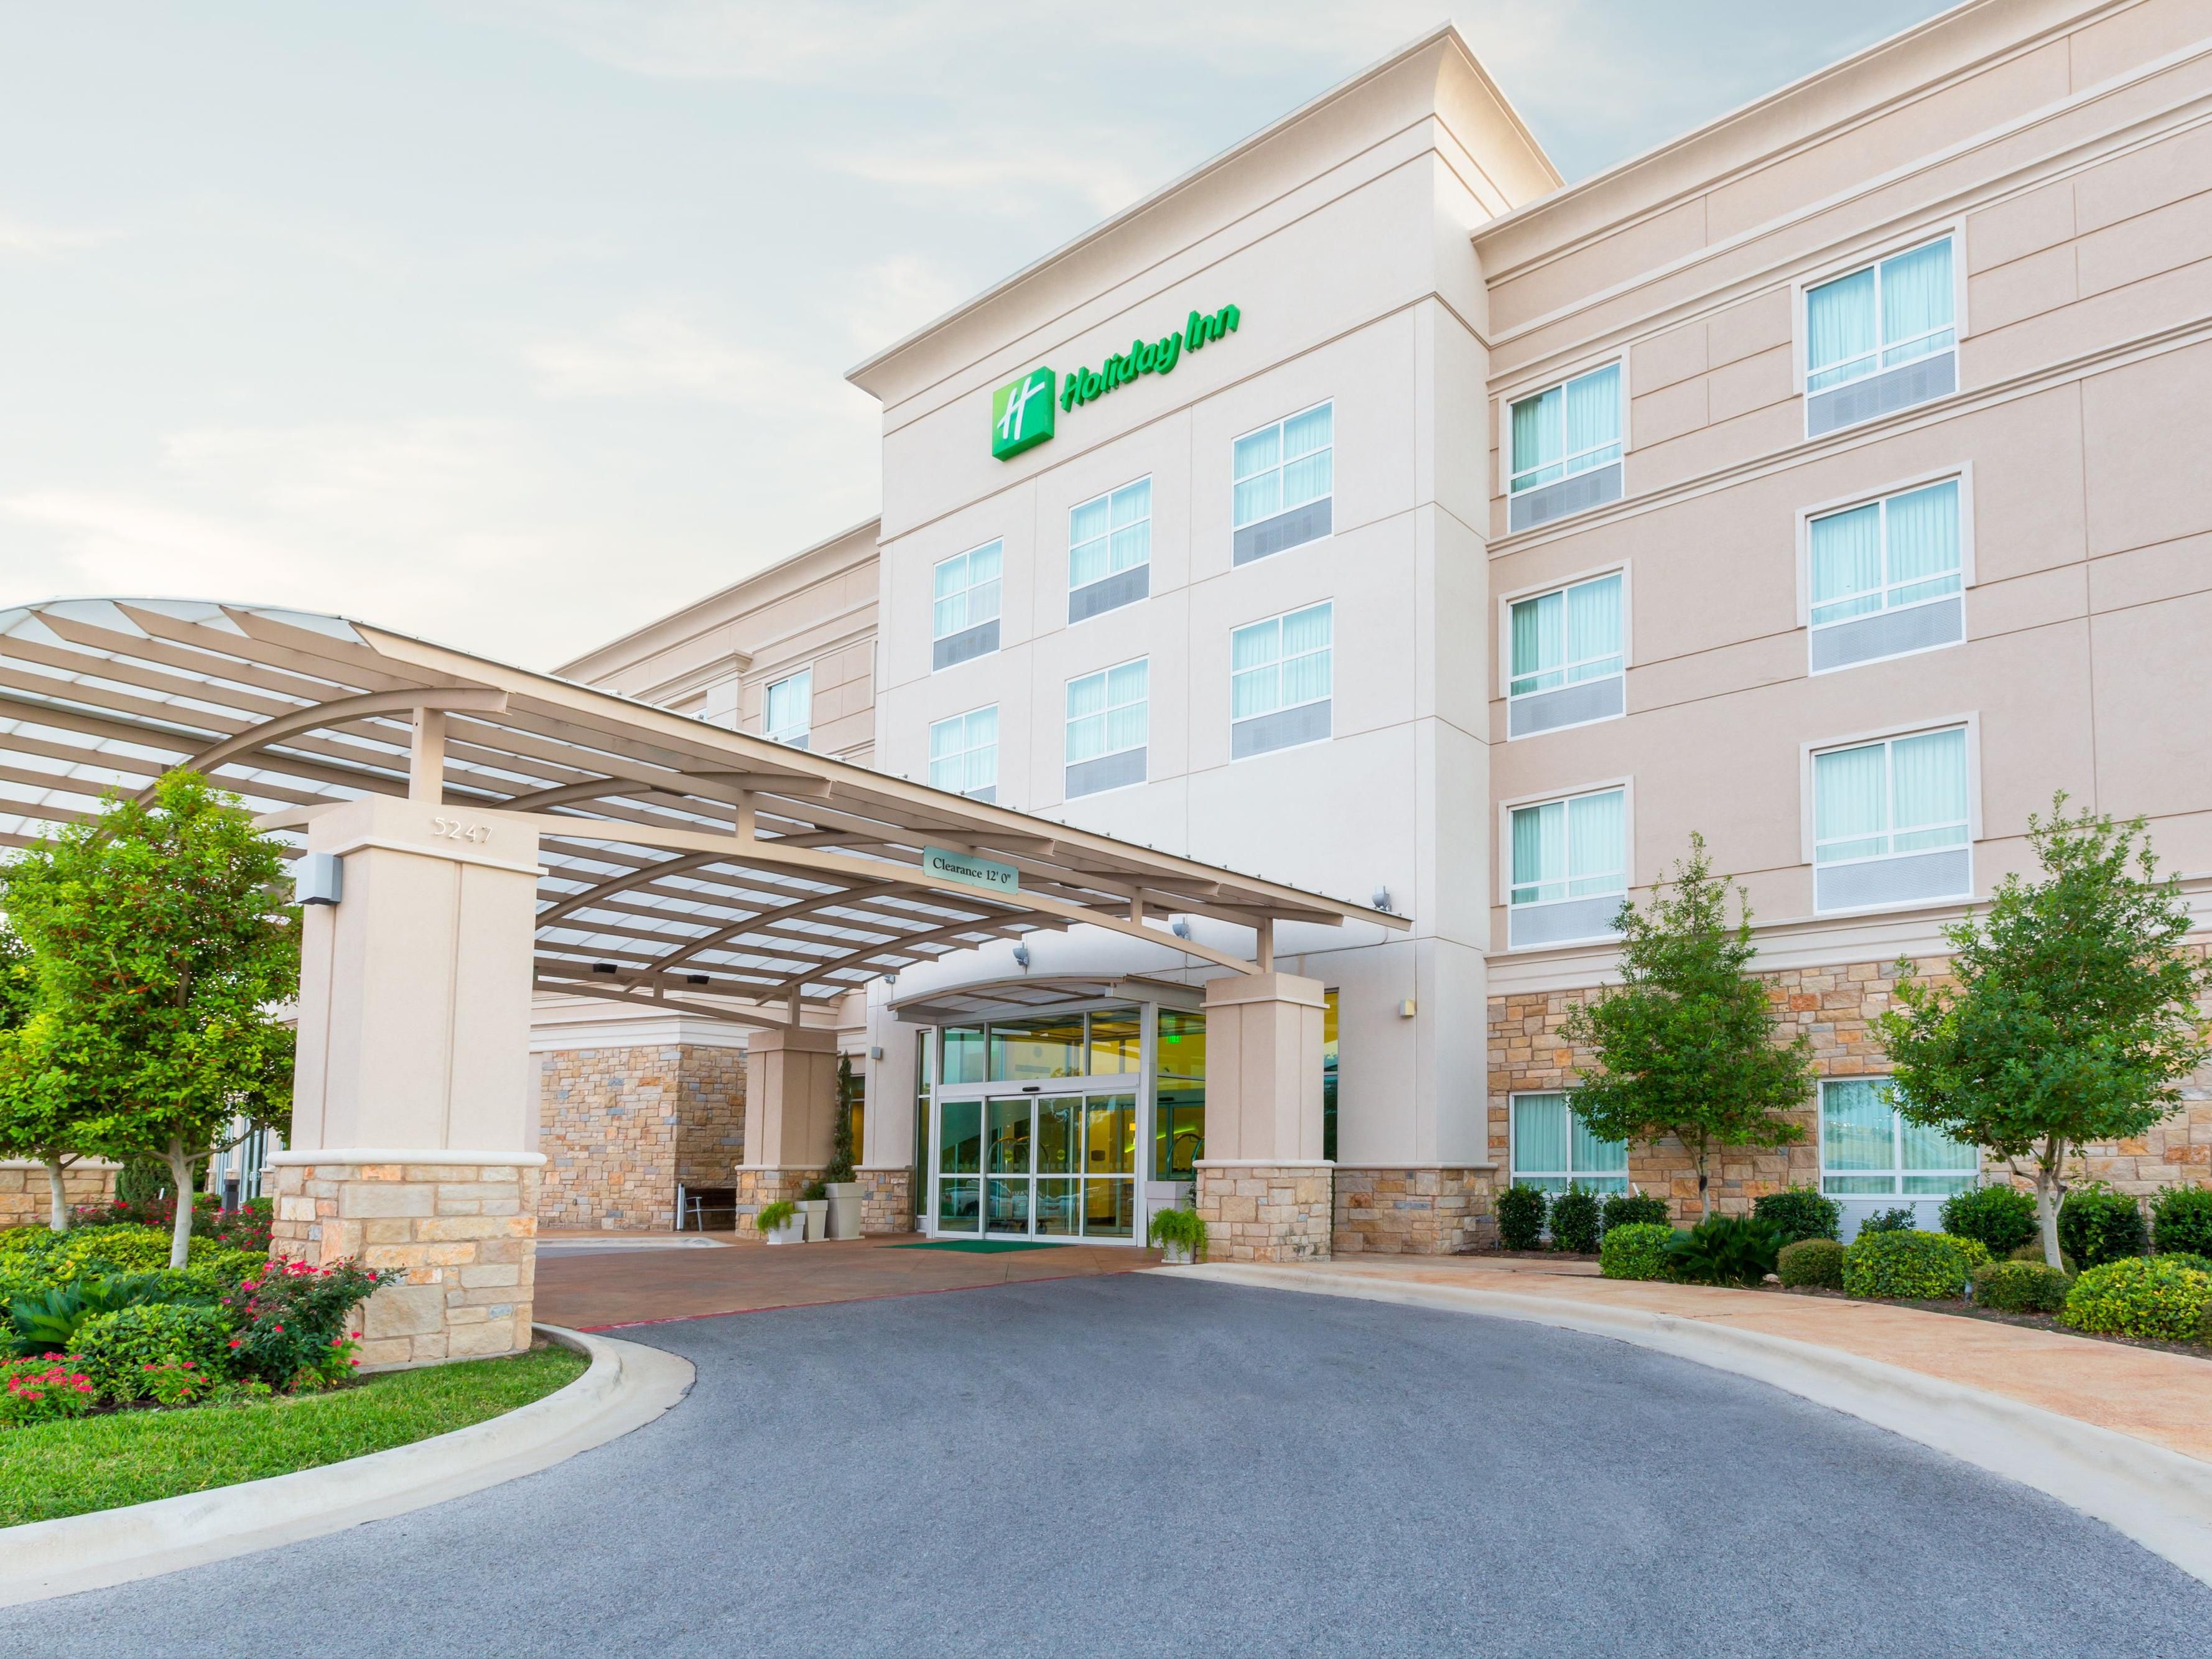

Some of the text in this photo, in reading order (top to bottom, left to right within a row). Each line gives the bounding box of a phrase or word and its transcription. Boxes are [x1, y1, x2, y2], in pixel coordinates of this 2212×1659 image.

[1060, 304, 1240, 412] Holiday Inn
[997, 376, 1045, 440] H
[434, 817, 493, 842] 5247
[933, 857, 982, 878] Clearance
[986, 870, 998, 881] 12'
